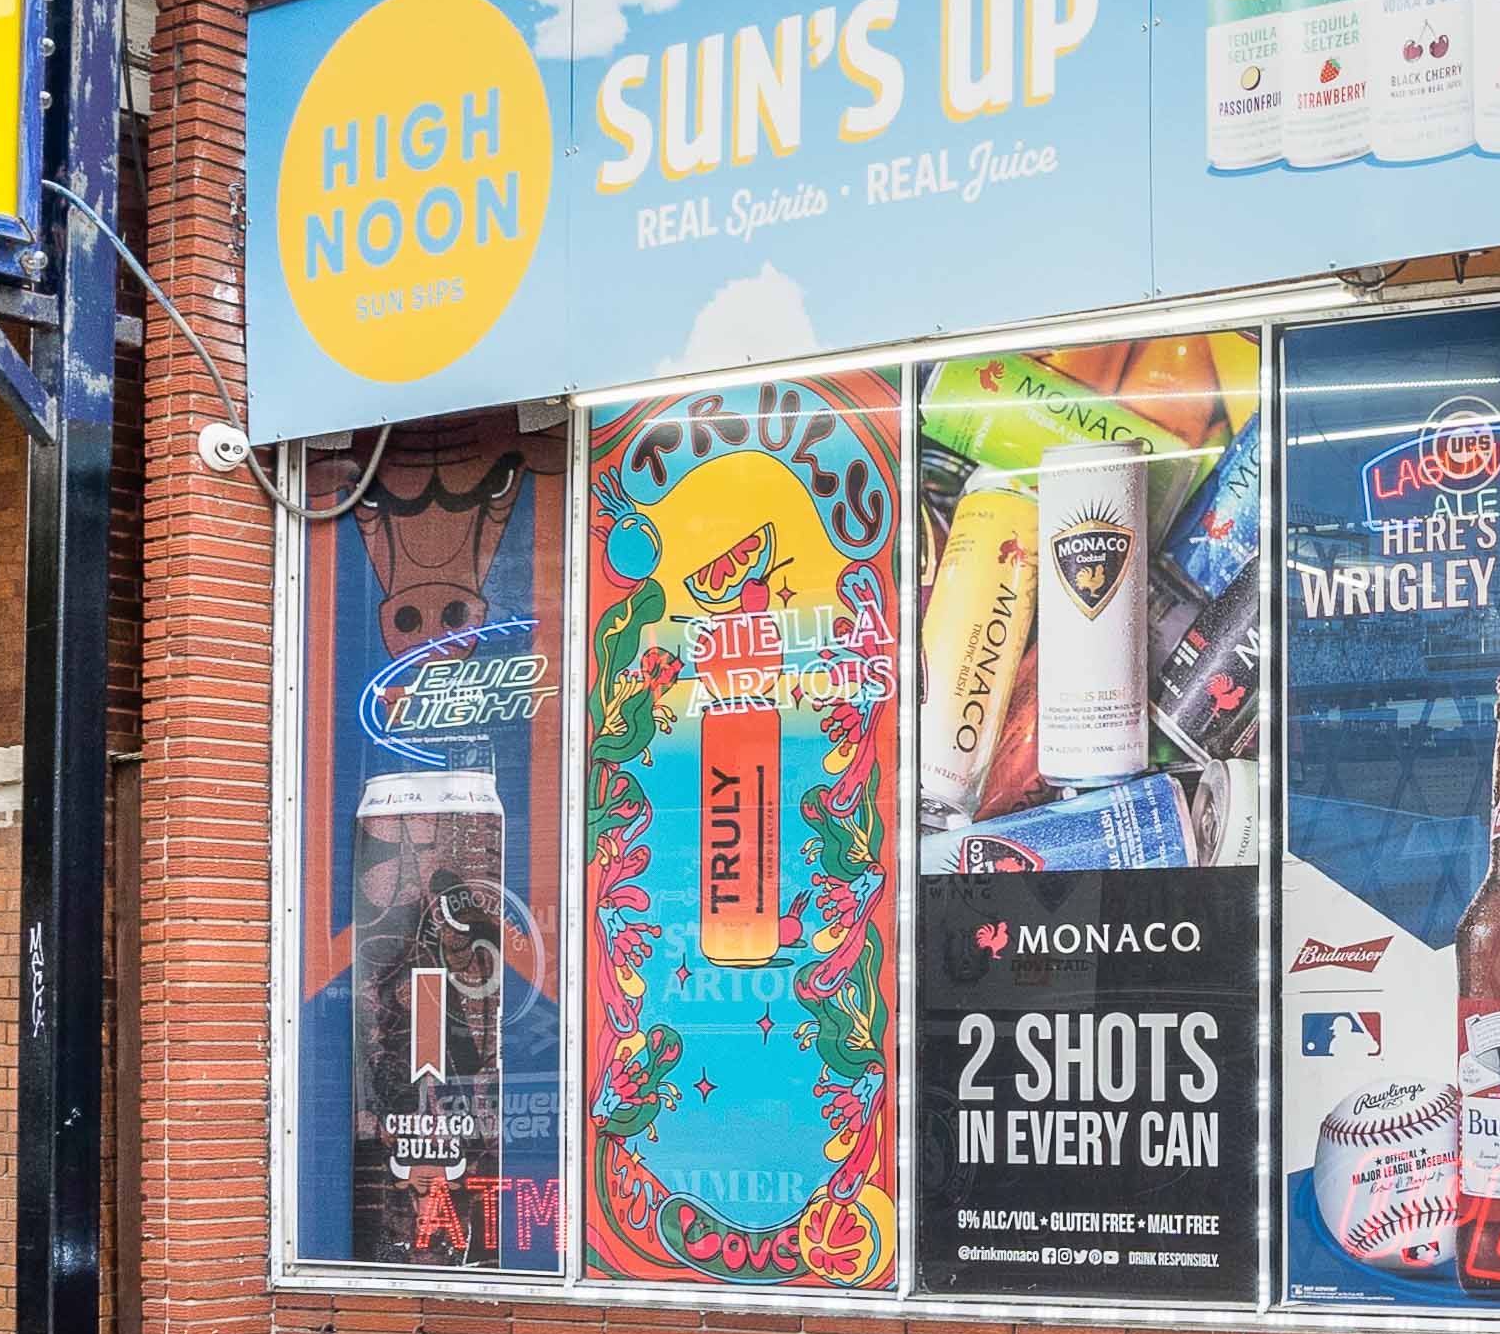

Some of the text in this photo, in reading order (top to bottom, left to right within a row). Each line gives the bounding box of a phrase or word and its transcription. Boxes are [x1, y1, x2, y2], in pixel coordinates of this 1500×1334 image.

[1303, 30, 1359, 52] SELTZER
[1304, 13, 1358, 36] TEQUILA
[1297, 82, 1365, 110] STRAWBERRY
[1391, 65, 1462, 88] BLACK CHERRY
[323, 87, 502, 192] HIGH
[636, 140, 1058, 250] REAL Spirits REAL Juice
[304, 170, 522, 279] NOON
[355, 276, 466, 322] SUN SIPS
[1015, 375, 1154, 455] MONACO
[632, 382, 883, 546] TRULY
[1058, 535, 1129, 558] MONACO
[1382, 517, 1497, 556] HERE'S
[1300, 557, 1496, 618] WRIGLEY
[686, 600, 895, 664] STELLA
[414, 655, 548, 695] BUD
[687, 655, 897, 716] ARTOIS
[954, 661, 970, 697] RUSH
[385, 686, 559, 732] LIGHT
[710, 766, 741, 915] TRULY
[1299, 945, 1383, 965] Budweiser
[958, 1011, 1219, 1102] 2 SHOTS
[1354, 1083, 1425, 1115] Rawlings
[386, 1114, 474, 1137] CHICAGO
[958, 1110, 1219, 1167] IN EVERY CAN
[397, 1138, 460, 1159] BULLS
[1385, 1149, 1418, 1165] OFFICIAL
[1352, 1169, 1381, 1185] MAJOR
[1383, 1163, 1413, 1179] LEAGUE
[1415, 1152, 1456, 1173] BASEBALL
[416, 1177, 568, 1251] ATM
[958, 1210, 1219, 1235] 9% ALC/VOL GLUTEN FREE MALT FREE
[958, 1246, 1039, 1263] @drinkmonaco
[1129, 1252, 1156, 1265] DRINK
